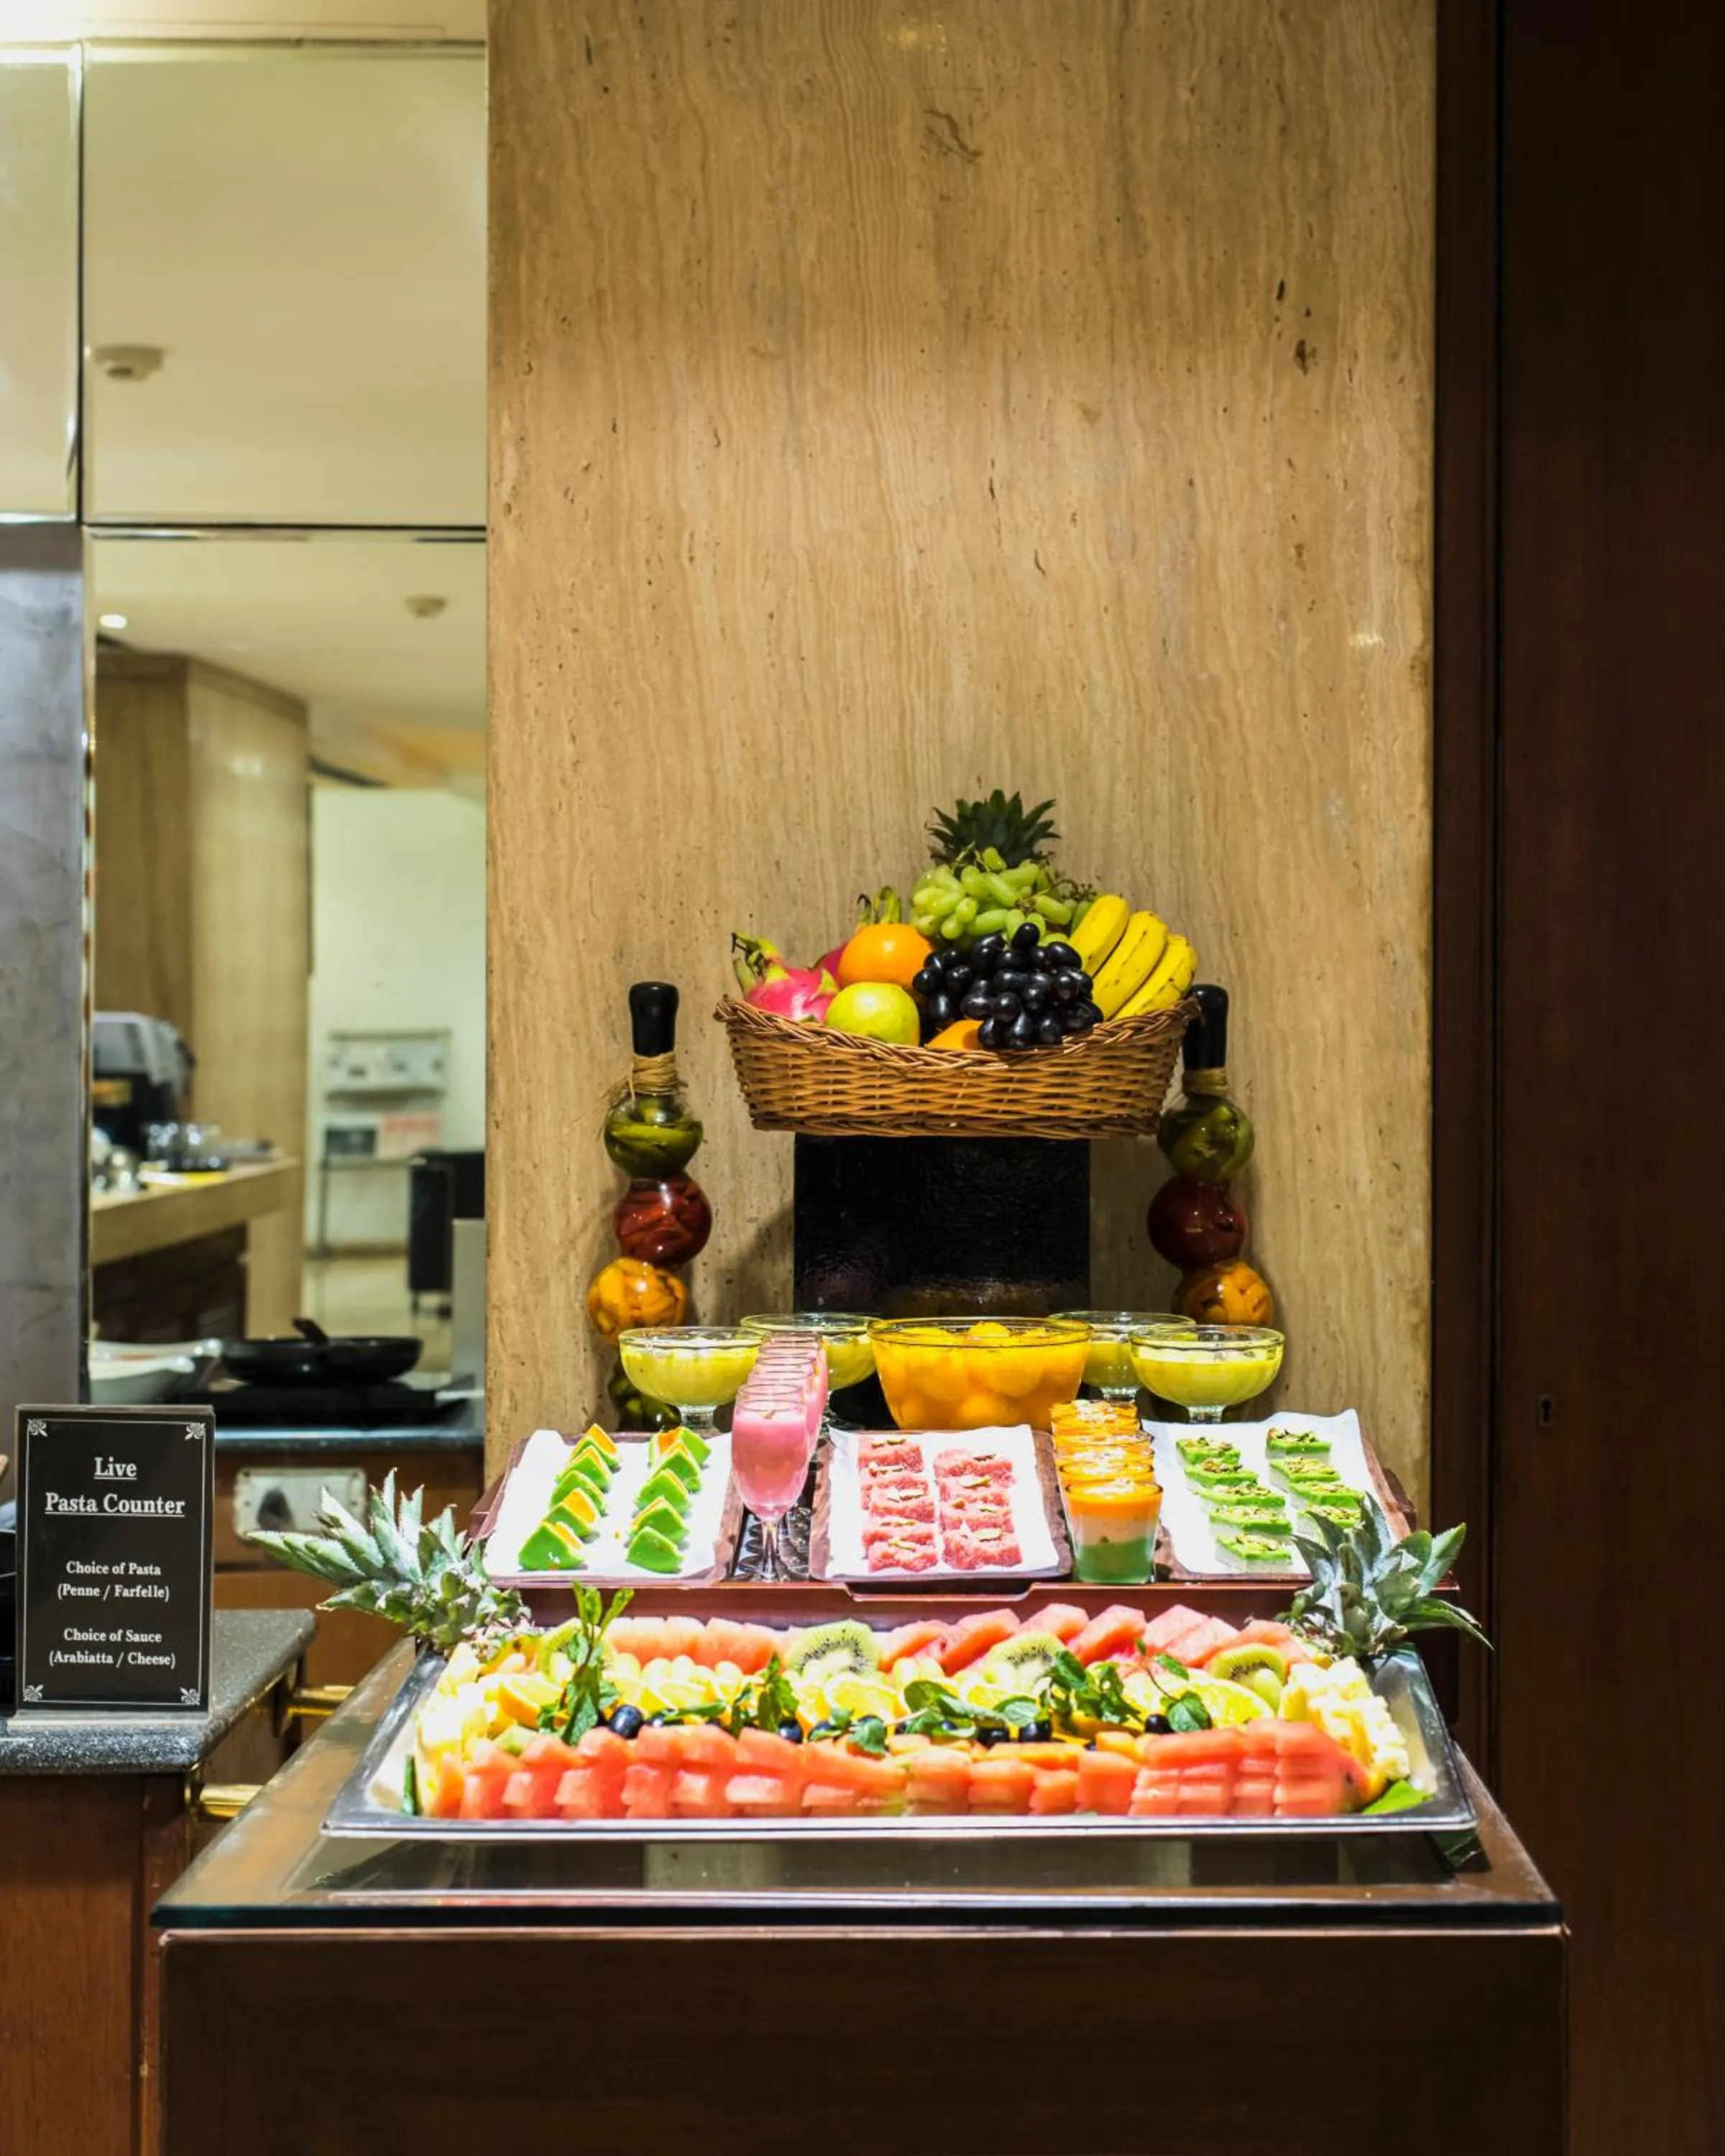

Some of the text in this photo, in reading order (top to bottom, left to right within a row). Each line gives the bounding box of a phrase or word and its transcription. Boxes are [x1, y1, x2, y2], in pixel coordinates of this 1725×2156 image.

[94, 1456, 137, 1477] Live
[45, 1492, 185, 1514] Pasta Counter
[65, 1560, 162, 1575] Choice of Pasta
[58, 1583, 101, 1600] (Penne
[63, 1627, 162, 1643] Choice of Sauce
[49, 1650, 114, 1667] (Arabiatta
[127, 1651, 176, 1669] Cheese)
